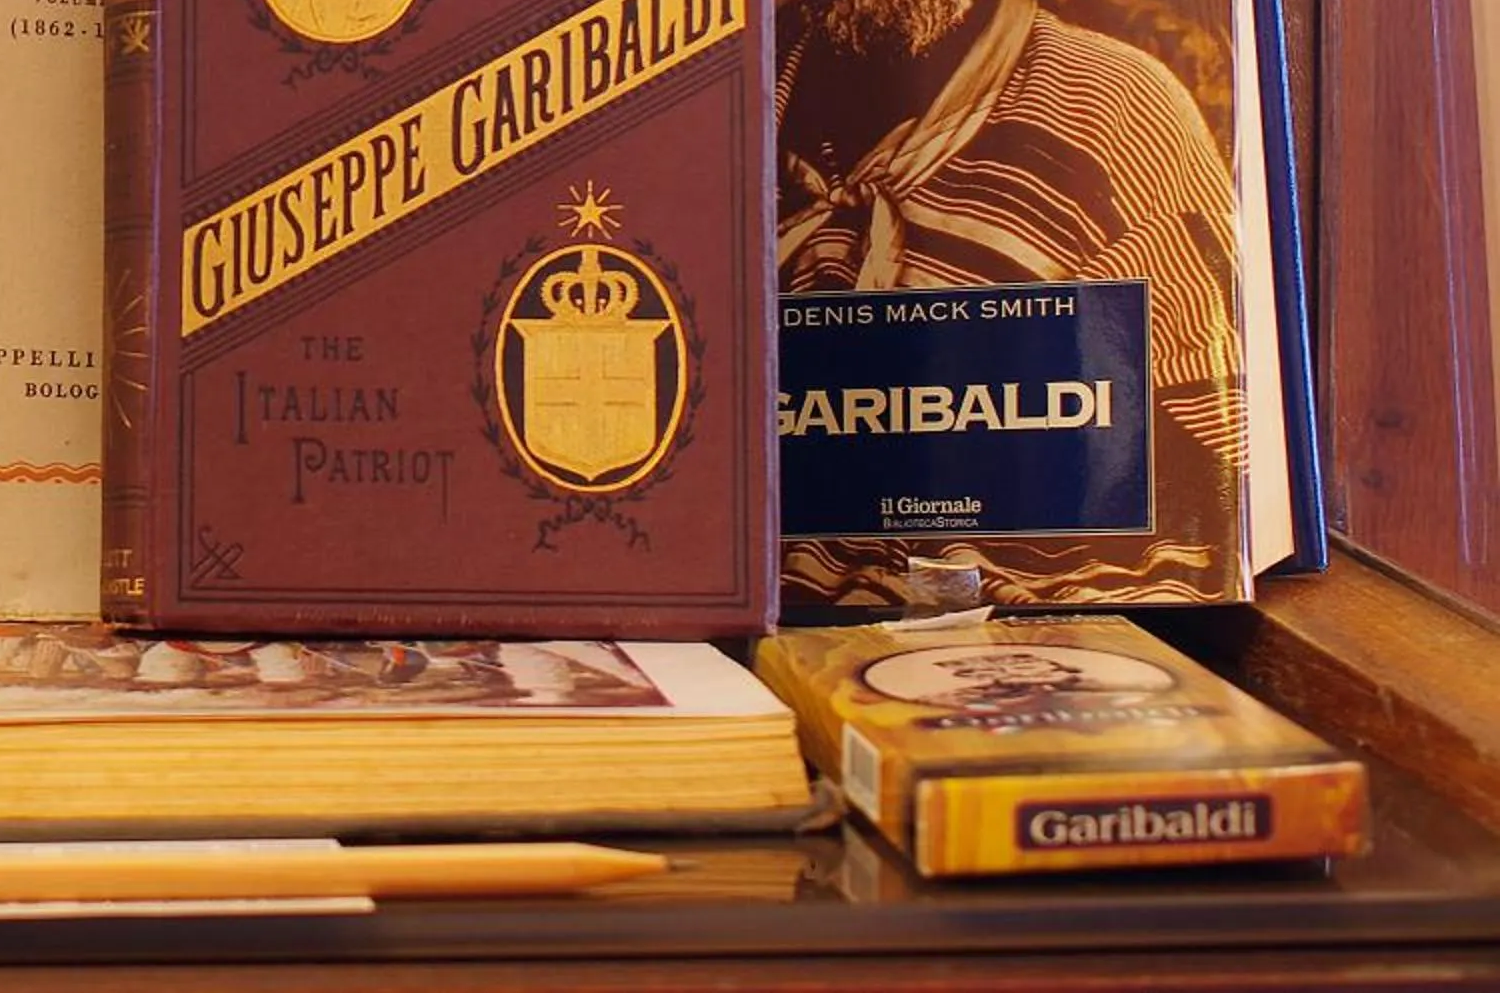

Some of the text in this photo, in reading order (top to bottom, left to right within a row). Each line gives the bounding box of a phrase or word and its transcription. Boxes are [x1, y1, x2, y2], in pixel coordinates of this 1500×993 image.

[192, 113, 427, 318] GIUSEPPE
[783, 296, 1076, 327] DENIS MACK SMITH
[300, 336, 364, 361] THE
[25, 382, 100, 399] BOLOG
[234, 371, 399, 445] ITALIAN
[778, 379, 1113, 437] GARIBALDI
[292, 436, 455, 524] PATRIOT
[880, 496, 982, 515] il Giornale
[1028, 800, 1257, 847] Garibaldi
